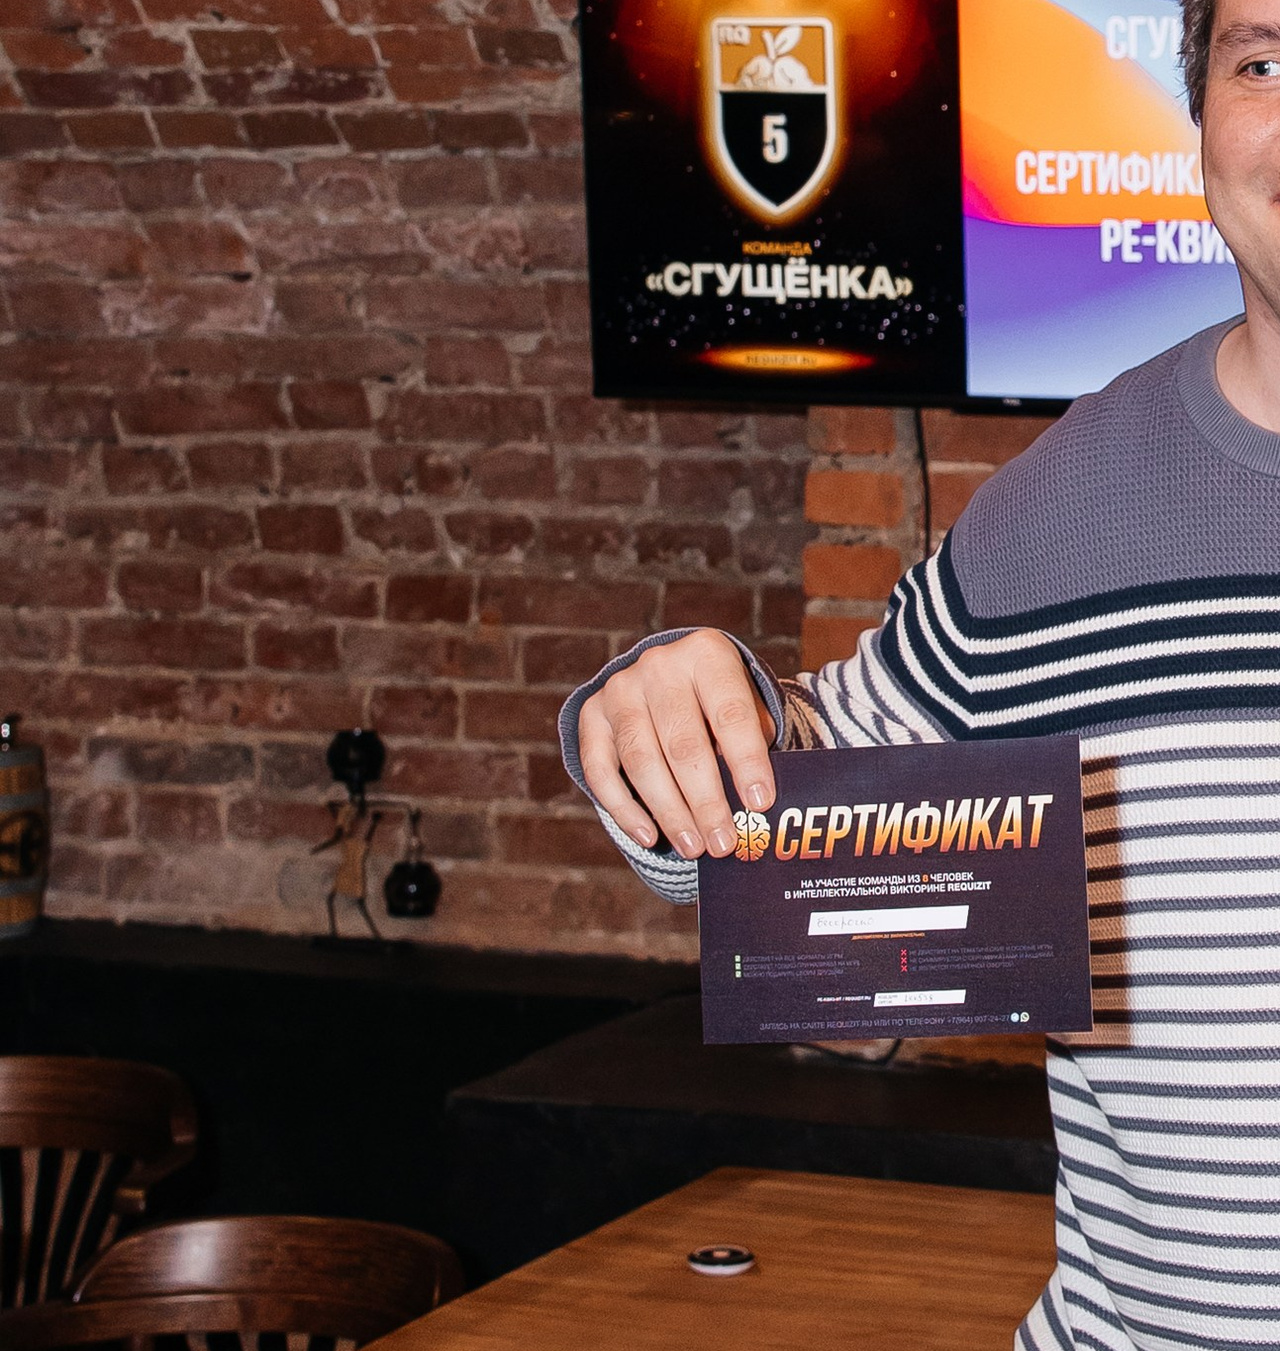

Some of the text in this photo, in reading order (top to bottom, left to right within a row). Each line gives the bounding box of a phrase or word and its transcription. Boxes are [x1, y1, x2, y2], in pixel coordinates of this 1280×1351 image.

[762, 115, 788, 163] 5
[742, 241, 812, 256] КОМАНДА
[645, 257, 913, 304] «СГУЩЁНКА»
[774, 794, 1053, 862] СЕРТИФИКАТ
[784, 881, 992, 899] В ИНТЕЛЛЕКТУАЛЬНОЙ ВИКТОРИНЕ REQUIZIT
[801, 872, 974, 888] НА УЧАСТИЕ КОМАНДЫ ИЗ 8 ЧЕЛОВЕК
